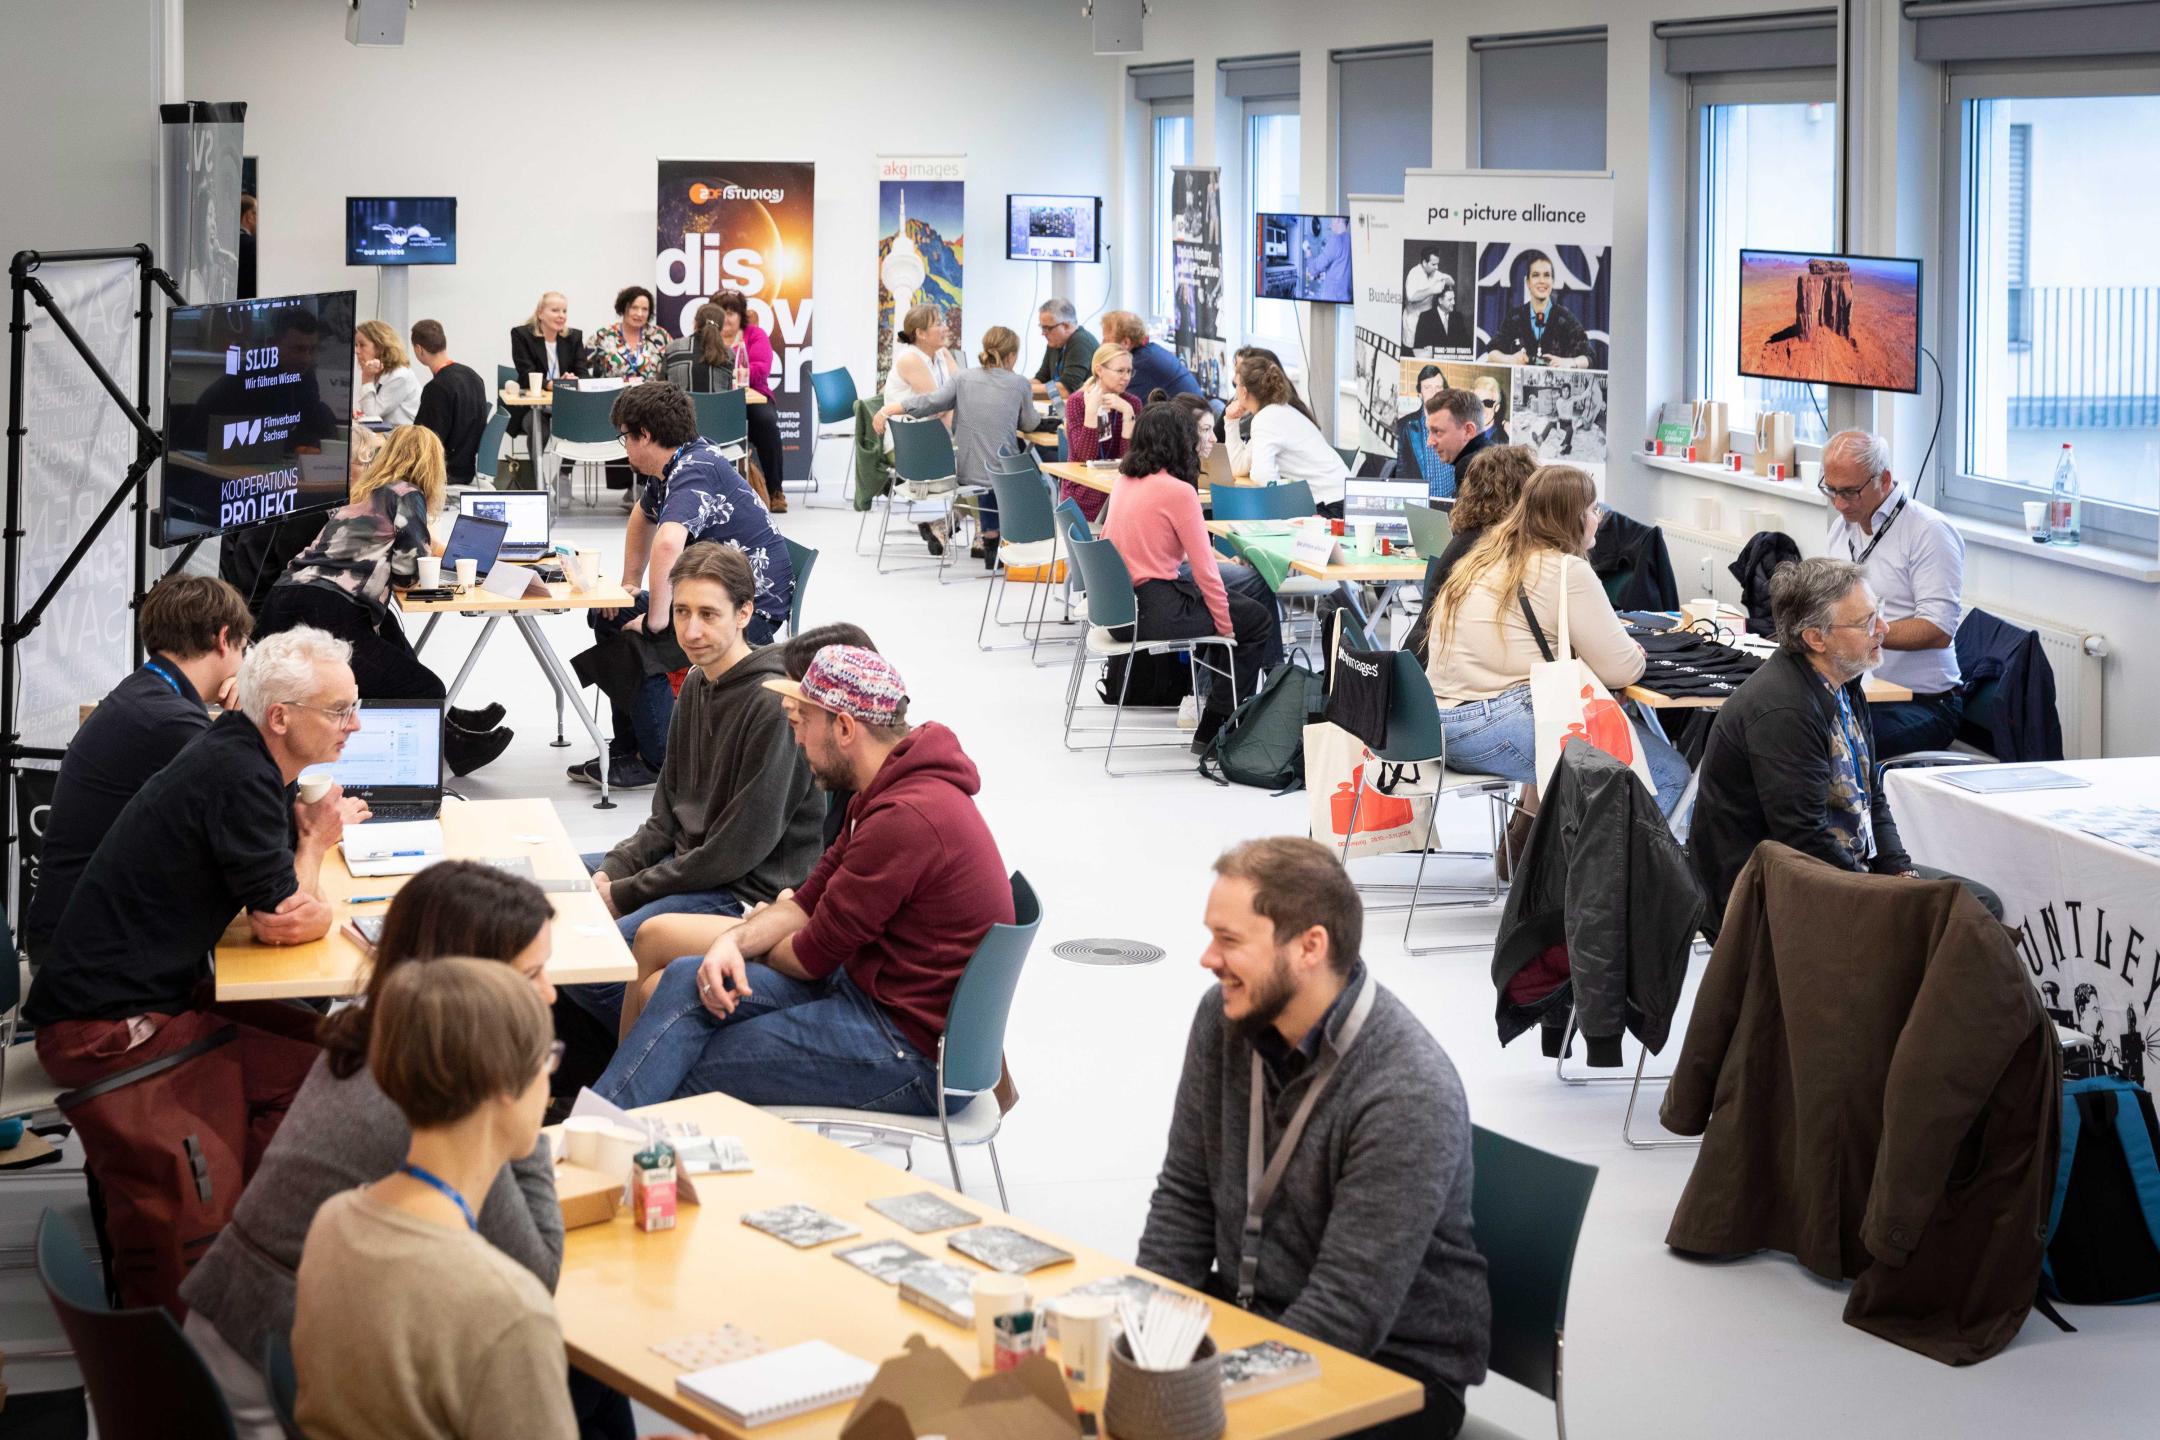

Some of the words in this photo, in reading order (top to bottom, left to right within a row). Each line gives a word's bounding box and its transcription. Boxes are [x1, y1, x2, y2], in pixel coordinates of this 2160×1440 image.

[1428, 207, 1449, 224] pa
[1463, 203, 1517, 226] picture
[1521, 203, 1586, 223] alliance
[656, 232, 765, 297] dis
[1368, 287, 1404, 304] Bundesa
[245, 346, 279, 371] SLUB
[245, 378, 256, 390] Wir
[257, 375, 278, 387] führen
[279, 372, 301, 384] Wissen.
[263, 410, 300, 427] Filmverband
[263, 429, 288, 442] Sachsen
[221, 467, 298, 501] KOOPERATIONS
[2016, 899, 2160, 1016] UNTLEY
